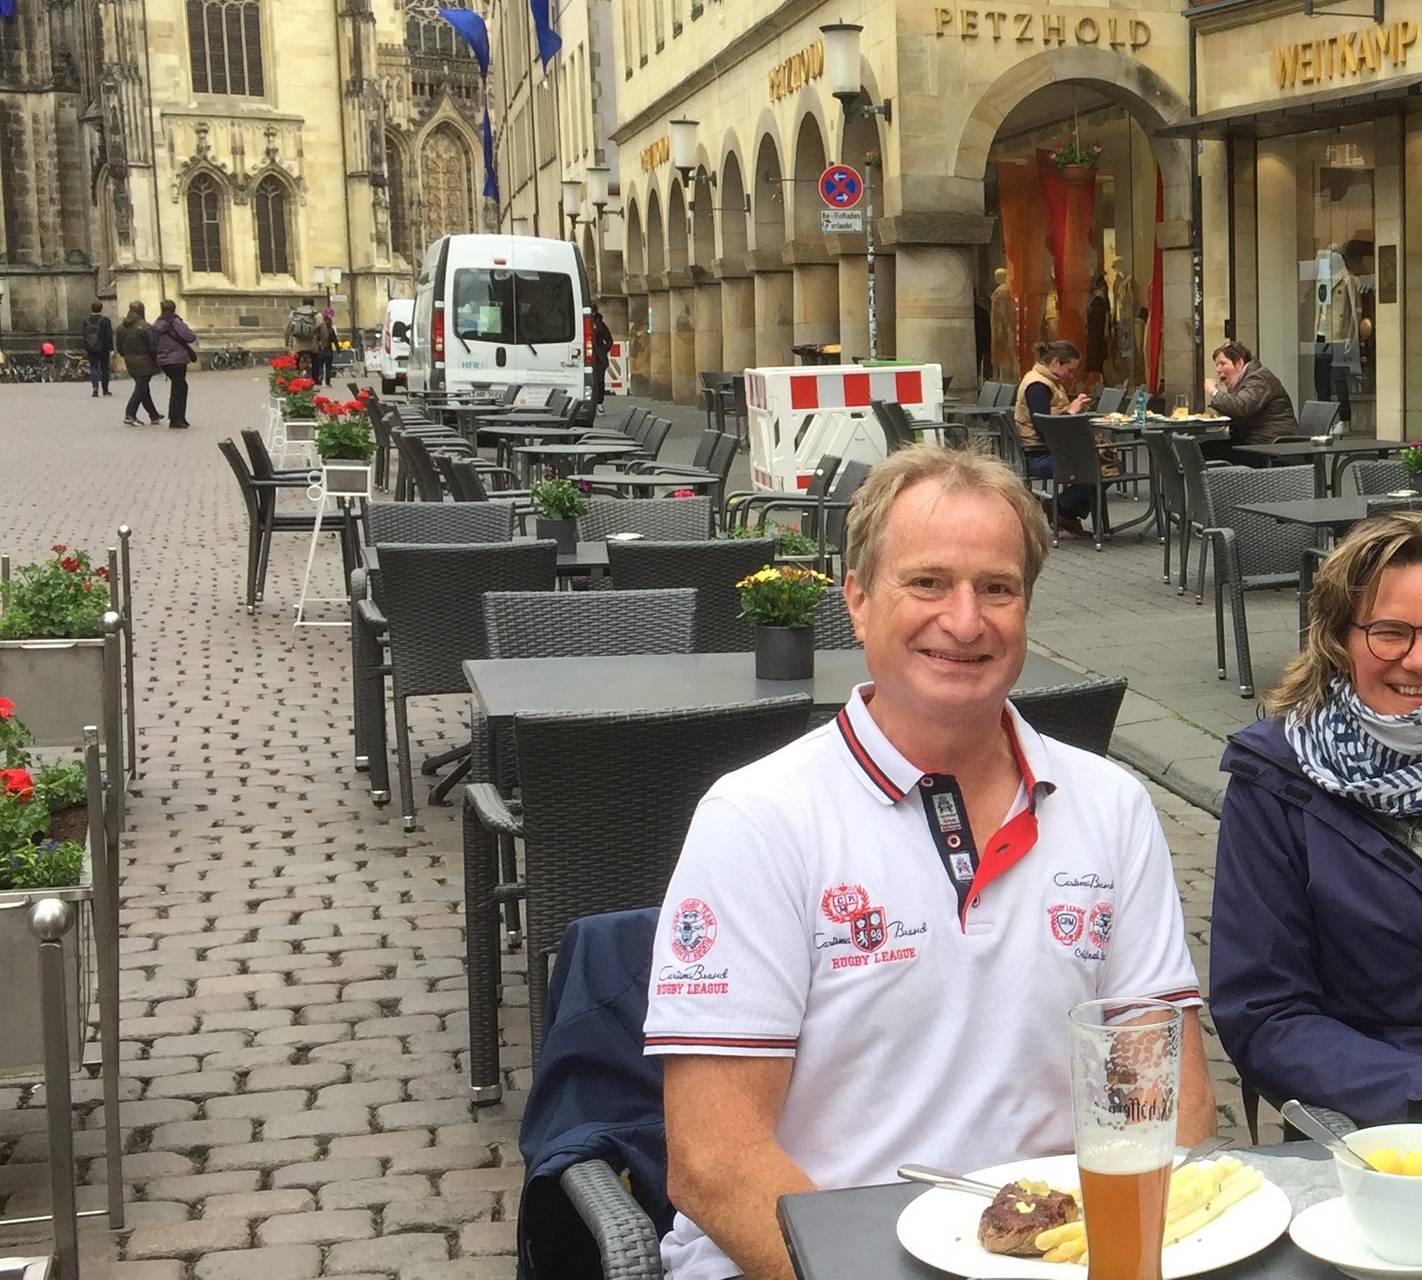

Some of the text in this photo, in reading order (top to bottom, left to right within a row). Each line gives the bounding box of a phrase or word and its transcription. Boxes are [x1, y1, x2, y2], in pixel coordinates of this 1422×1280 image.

[935, 8, 1151, 50] PETZHOLD
[1275, 21, 1418, 88] WEITKAMP
[462, 361, 480, 369] HFR
[832, 948, 917, 970] RUGBY LEAGUE
[657, 983, 729, 995] RUGBY LEAGUE
